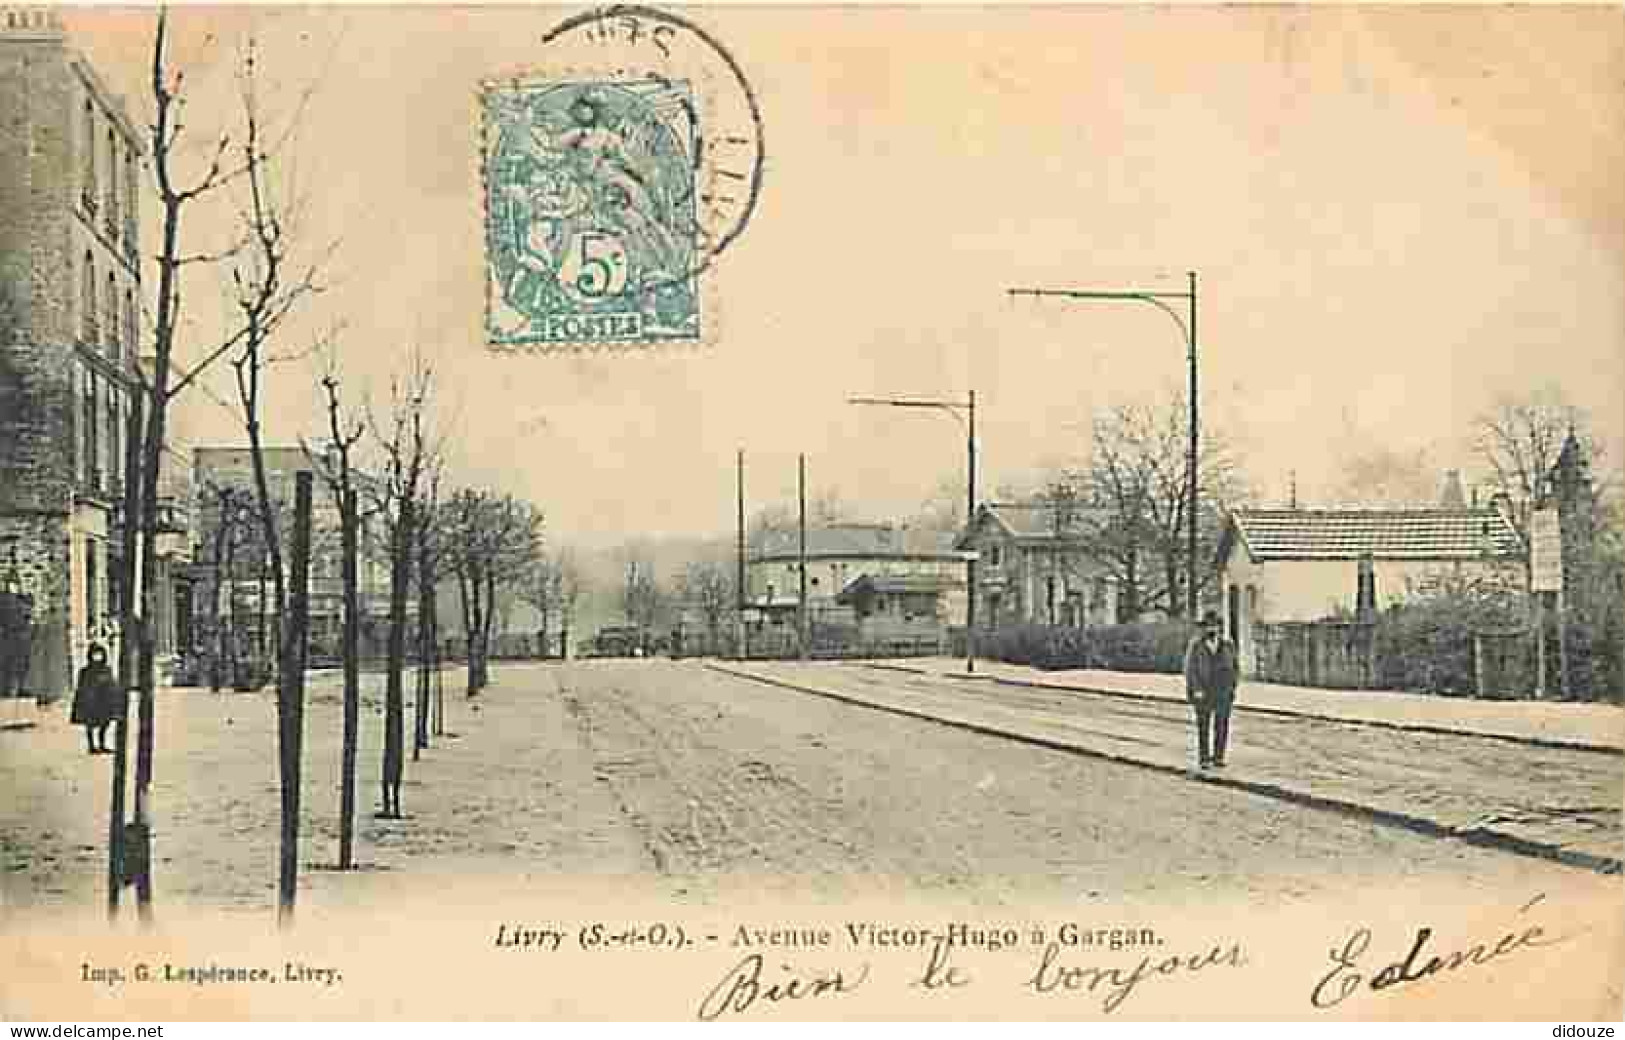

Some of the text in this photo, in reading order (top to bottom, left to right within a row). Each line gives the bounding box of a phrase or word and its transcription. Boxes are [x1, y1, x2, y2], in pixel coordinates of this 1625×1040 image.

[495, 924, 567, 950] Livry
[730, 925, 831, 947] Avenue
[846, 923, 1019, 951] Victor-Hugo
[1057, 923, 1165, 950] Gargan.
[81, 963, 125, 986] Imp.
[284, 962, 342, 985] Livry.
[699, 953, 870, 1020] Bien
